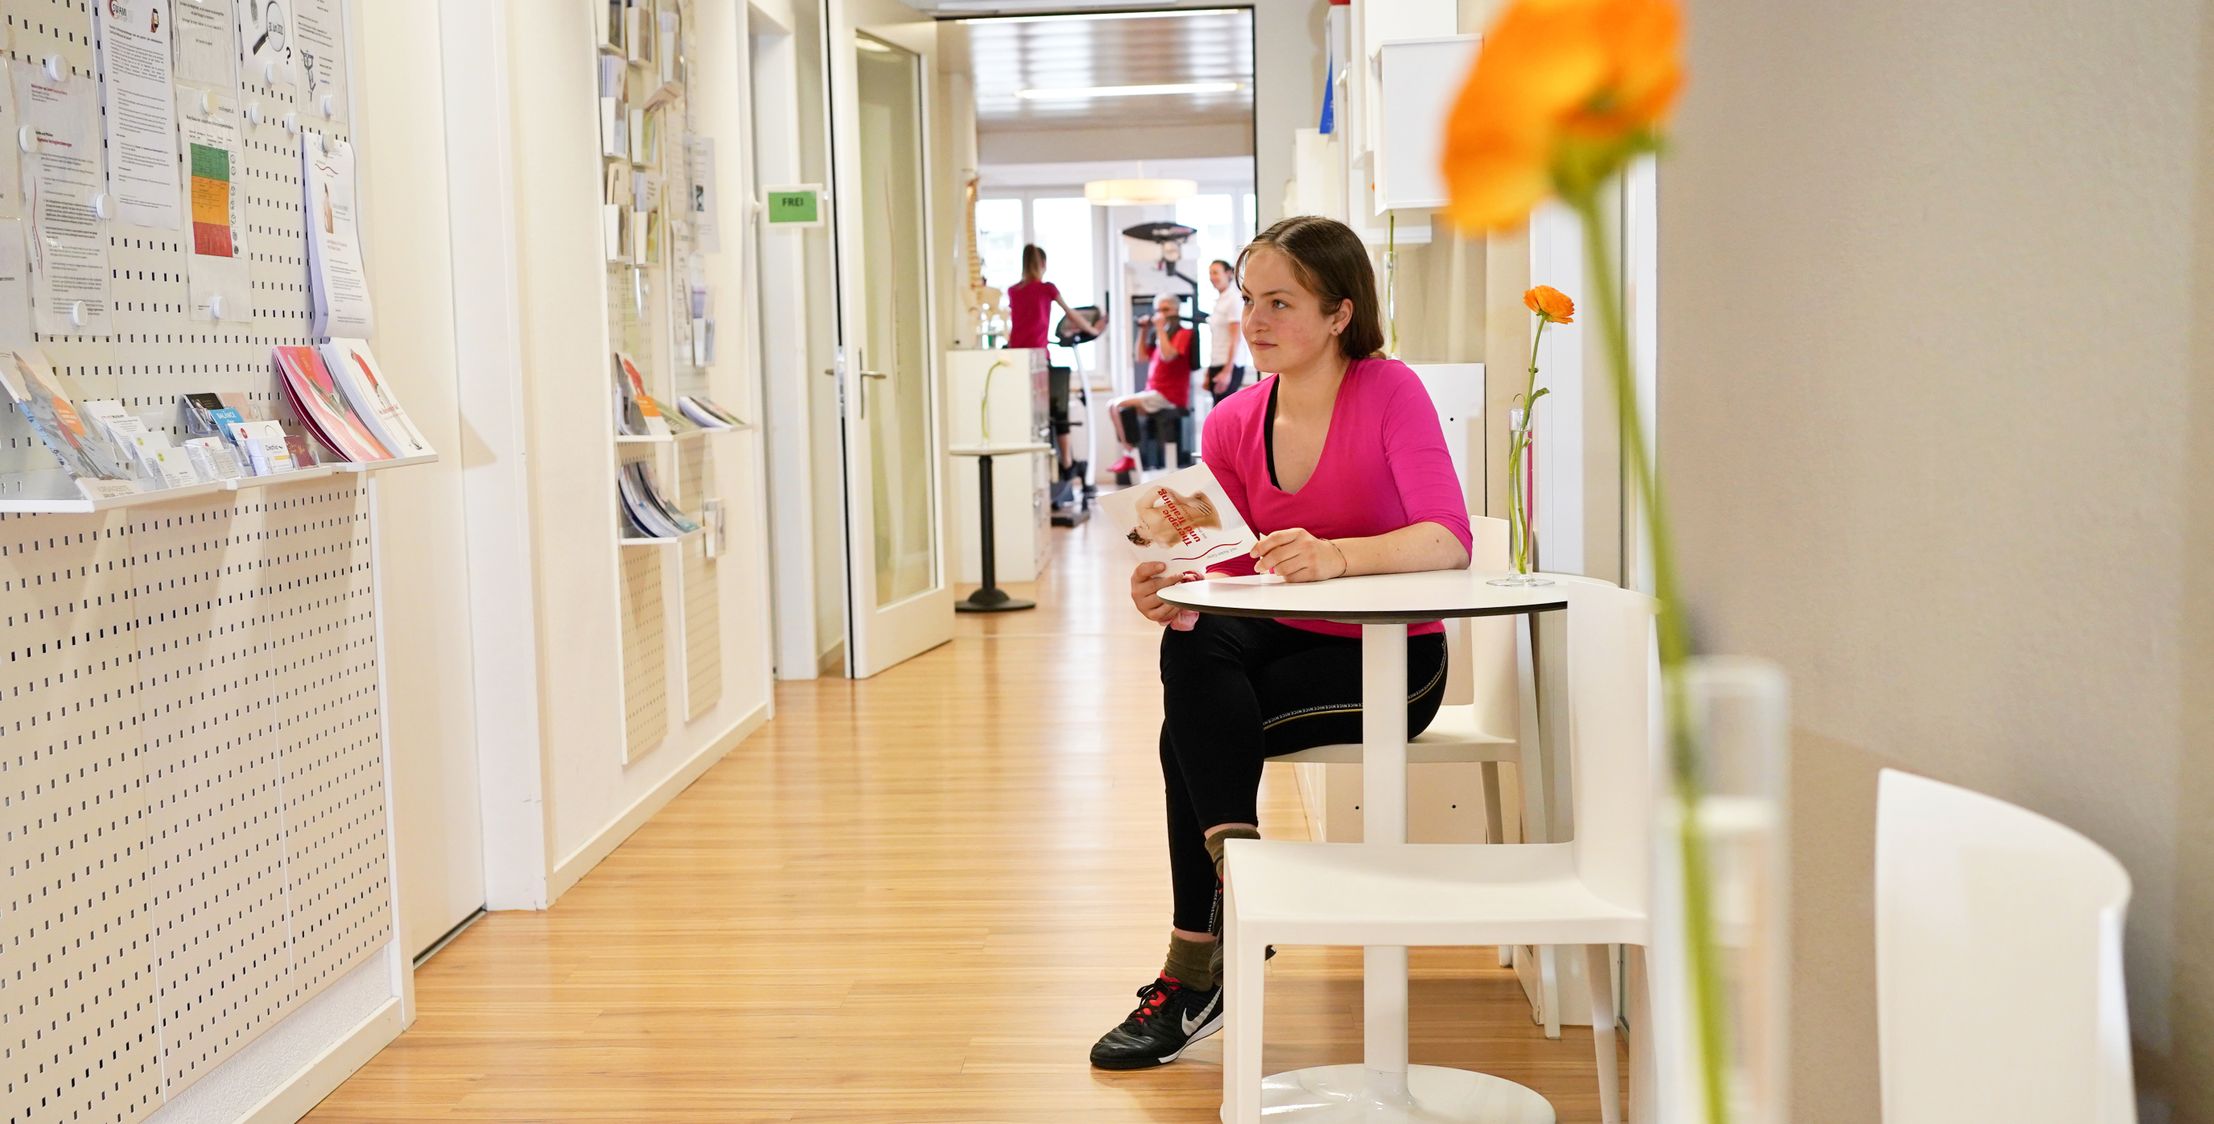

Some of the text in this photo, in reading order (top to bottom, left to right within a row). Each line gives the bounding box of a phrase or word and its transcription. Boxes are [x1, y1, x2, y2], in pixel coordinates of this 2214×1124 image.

[782, 197, 804, 207] FREI
[1157, 488, 1201, 543] und Training
[1162, 509, 1193, 546] Therapie
